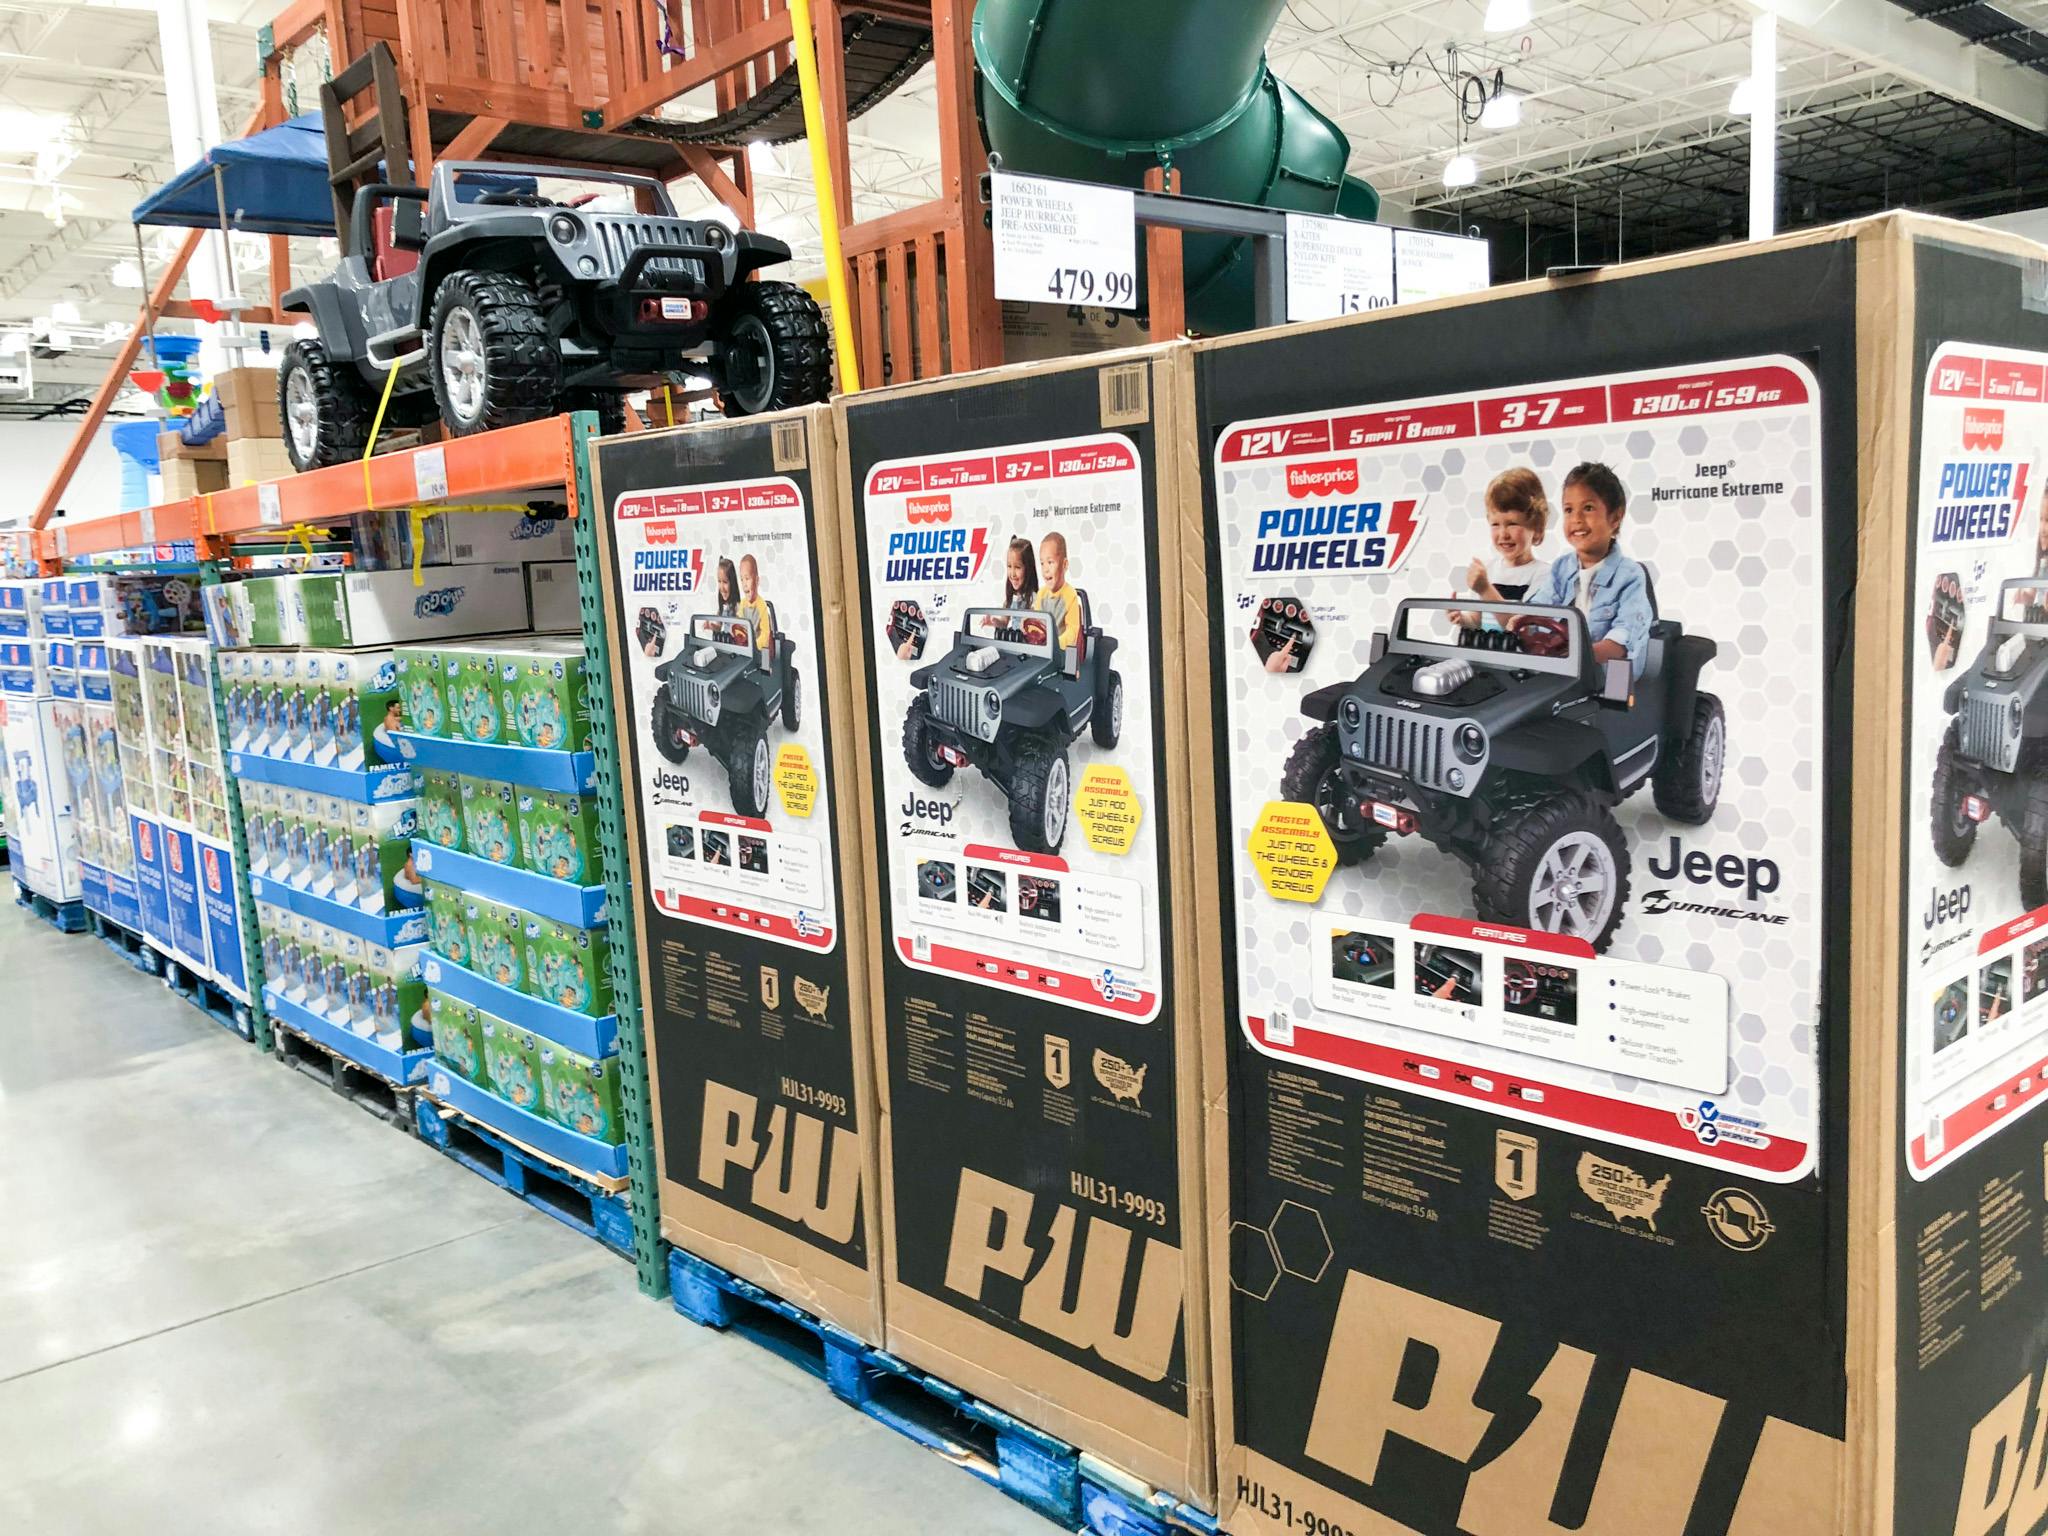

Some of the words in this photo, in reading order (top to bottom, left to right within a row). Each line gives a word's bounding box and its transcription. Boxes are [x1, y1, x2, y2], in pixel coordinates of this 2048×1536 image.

[1001, 195, 1033, 208] POWER
[1036, 199, 1073, 212] WHEELS
[1001, 207, 1022, 219] JEEP
[1025, 211, 1079, 225] HURRICANE
[1001, 219, 1077, 235] PRE-ASSEMBLED
[1048, 267, 1133, 304] 479.99
[1939, 368, 1965, 391] 12V
[1500, 398, 1560, 429] 3-7
[1240, 430, 1291, 457] 12V
[1005, 462, 1032, 479] 3-7
[1290, 467, 1356, 487] fisher-price
[877, 475, 902, 492] 12V
[1939, 463, 2012, 499] POWER
[1651, 486, 1718, 501] Hurricane
[1721, 482, 1783, 497] Extreme
[623, 504, 641, 516] 12V
[1090, 501, 1122, 514] Extreme
[1257, 503, 1382, 539] POWER
[1932, 504, 2010, 543] WHEELS
[889, 529, 966, 555] POWER
[635, 550, 688, 570] POWER
[1252, 538, 1386, 572] WHEELS
[886, 556, 969, 582] WHEELS
[634, 572, 692, 592] WHEELS
[370, 763, 400, 772] FAMILY
[653, 767, 690, 796] Jeep
[902, 791, 953, 827] Jeep
[1088, 798, 1108, 808] JUST
[1109, 800, 1127, 811] ADD
[1081, 808, 1096, 819] THE
[1097, 811, 1129, 823] WHEELS
[1270, 815, 1310, 826] FASTER
[1092, 822, 1125, 834] FENDER
[1261, 825, 1320, 838] ASSEMBLY
[1092, 834, 1126, 847] SCREWS
[1267, 839, 1292, 851] JUST
[1295, 842, 1317, 853] ADD
[1256, 851, 1276, 862] THE
[1278, 854, 1318, 867] WHEELS
[1648, 836, 1780, 901] Jeep
[1271, 867, 1313, 879] FENDER
[1271, 879, 1314, 894] SCREWS
[1924, 885, 1970, 930] Jeep
[1472, 926, 1528, 944] FEATURES
[1051, 1048, 1062, 1075] 1
[781, 1076, 847, 1117] HJL31-9993
[1505, 1148, 1523, 1182] 1
[1586, 1177, 1618, 1191] SERVICE
[1070, 1171, 1167, 1227] HJL31-9993
[1604, 1197, 1636, 1211] SERVICE
[1238, 1474, 1356, 1536] HJL31-99
